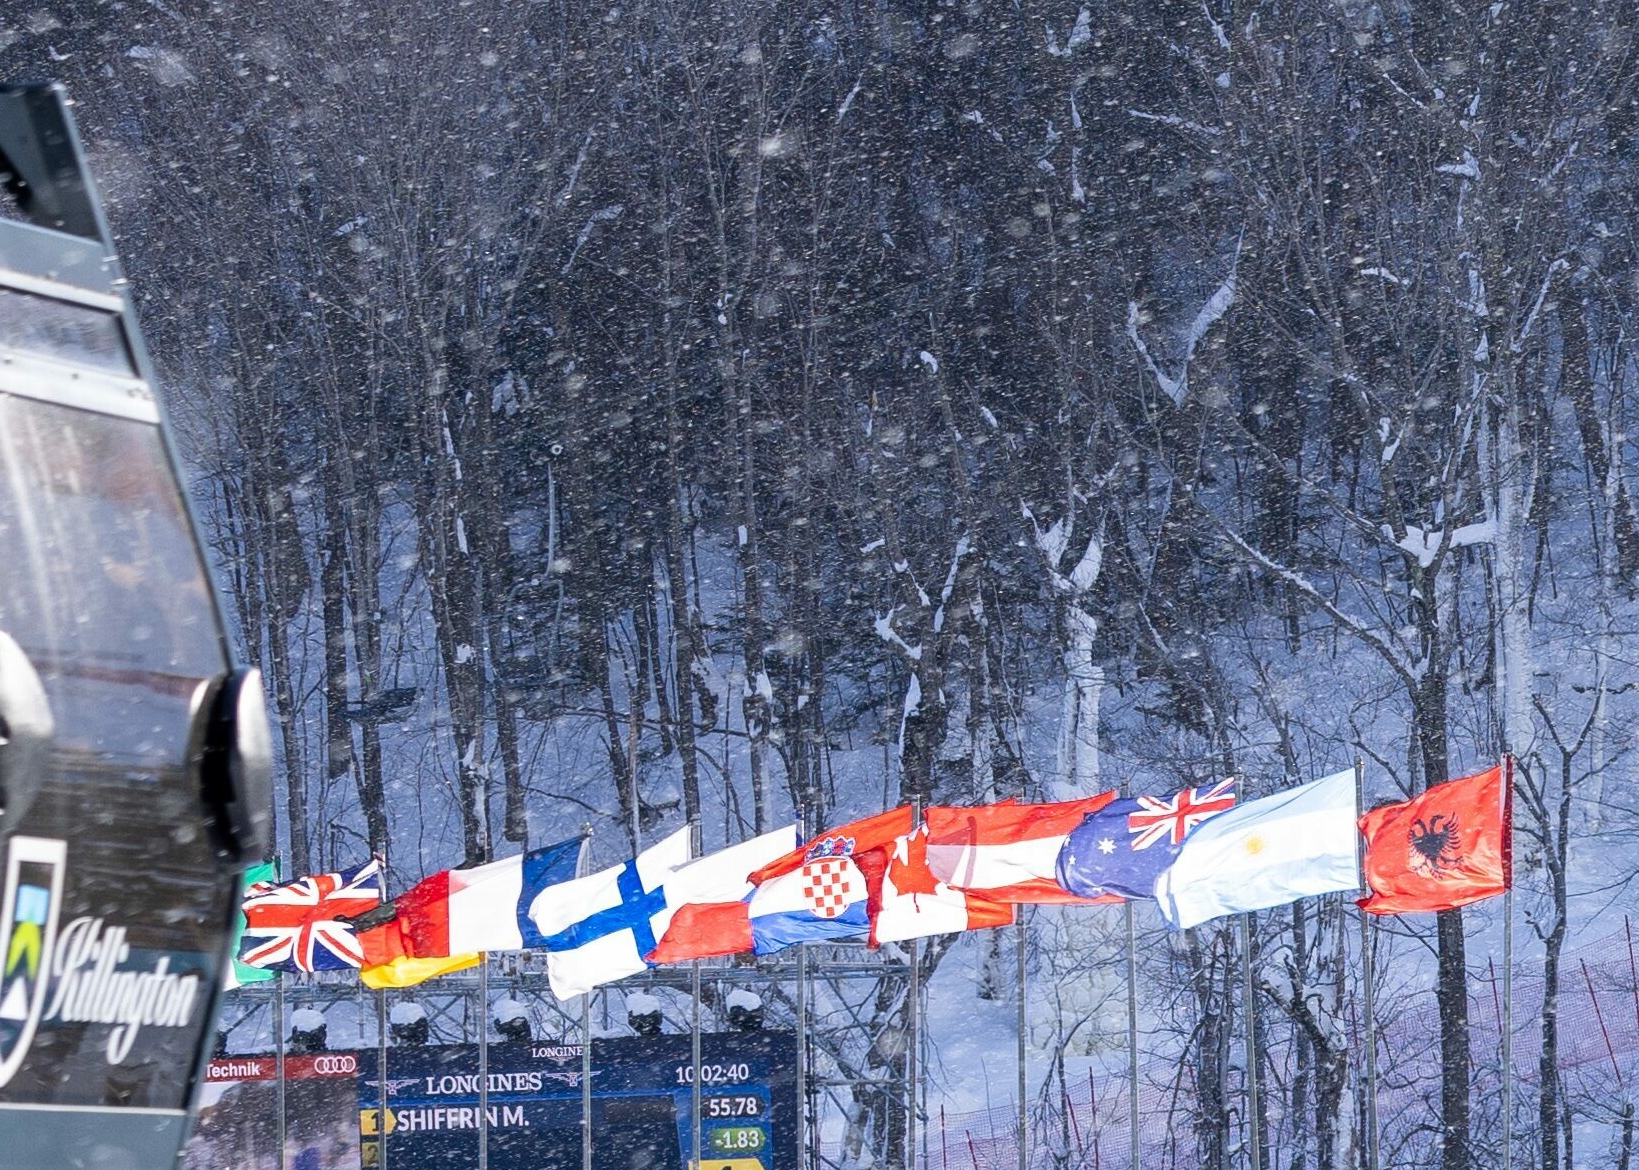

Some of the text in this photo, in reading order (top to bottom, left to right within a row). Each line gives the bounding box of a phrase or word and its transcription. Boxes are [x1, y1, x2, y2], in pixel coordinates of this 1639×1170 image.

[43, 916, 209, 1066] Killington
[532, 1046, 585, 1060] LONGINE
[426, 1071, 544, 1097] LONGINES
[397, 1105, 497, 1132] SHIFFRIN
[501, 1105, 531, 1128] M.
[709, 1096, 758, 1118] 55.78
[715, 1129, 760, 1150] -1.83
